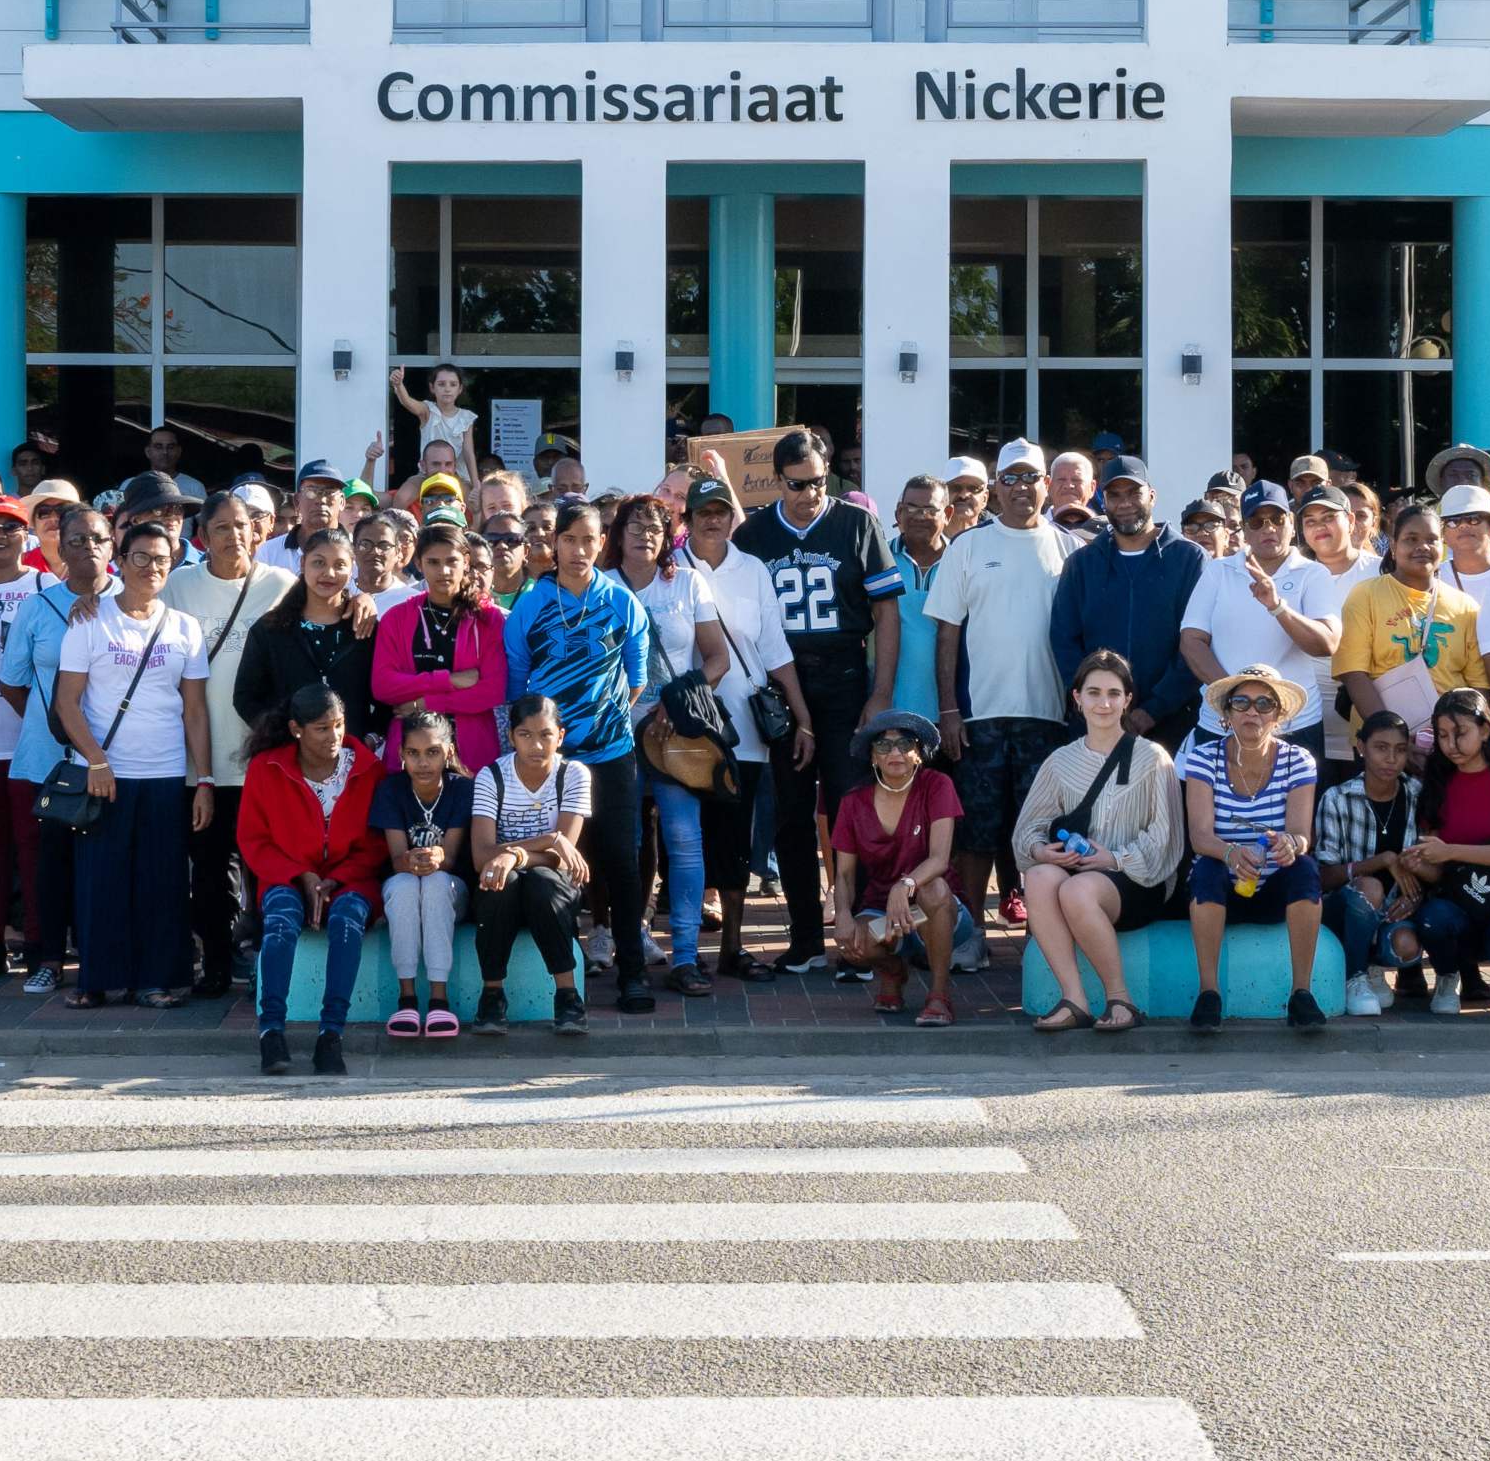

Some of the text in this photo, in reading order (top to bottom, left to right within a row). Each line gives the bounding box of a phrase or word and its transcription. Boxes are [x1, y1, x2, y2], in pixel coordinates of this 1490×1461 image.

[377, 67, 1166, 123] Commissariaat Nickerie
[775, 566, 838, 630] 22
[114, 653, 165, 670] EACH HER
[1463, 884, 1485, 904] adidas
